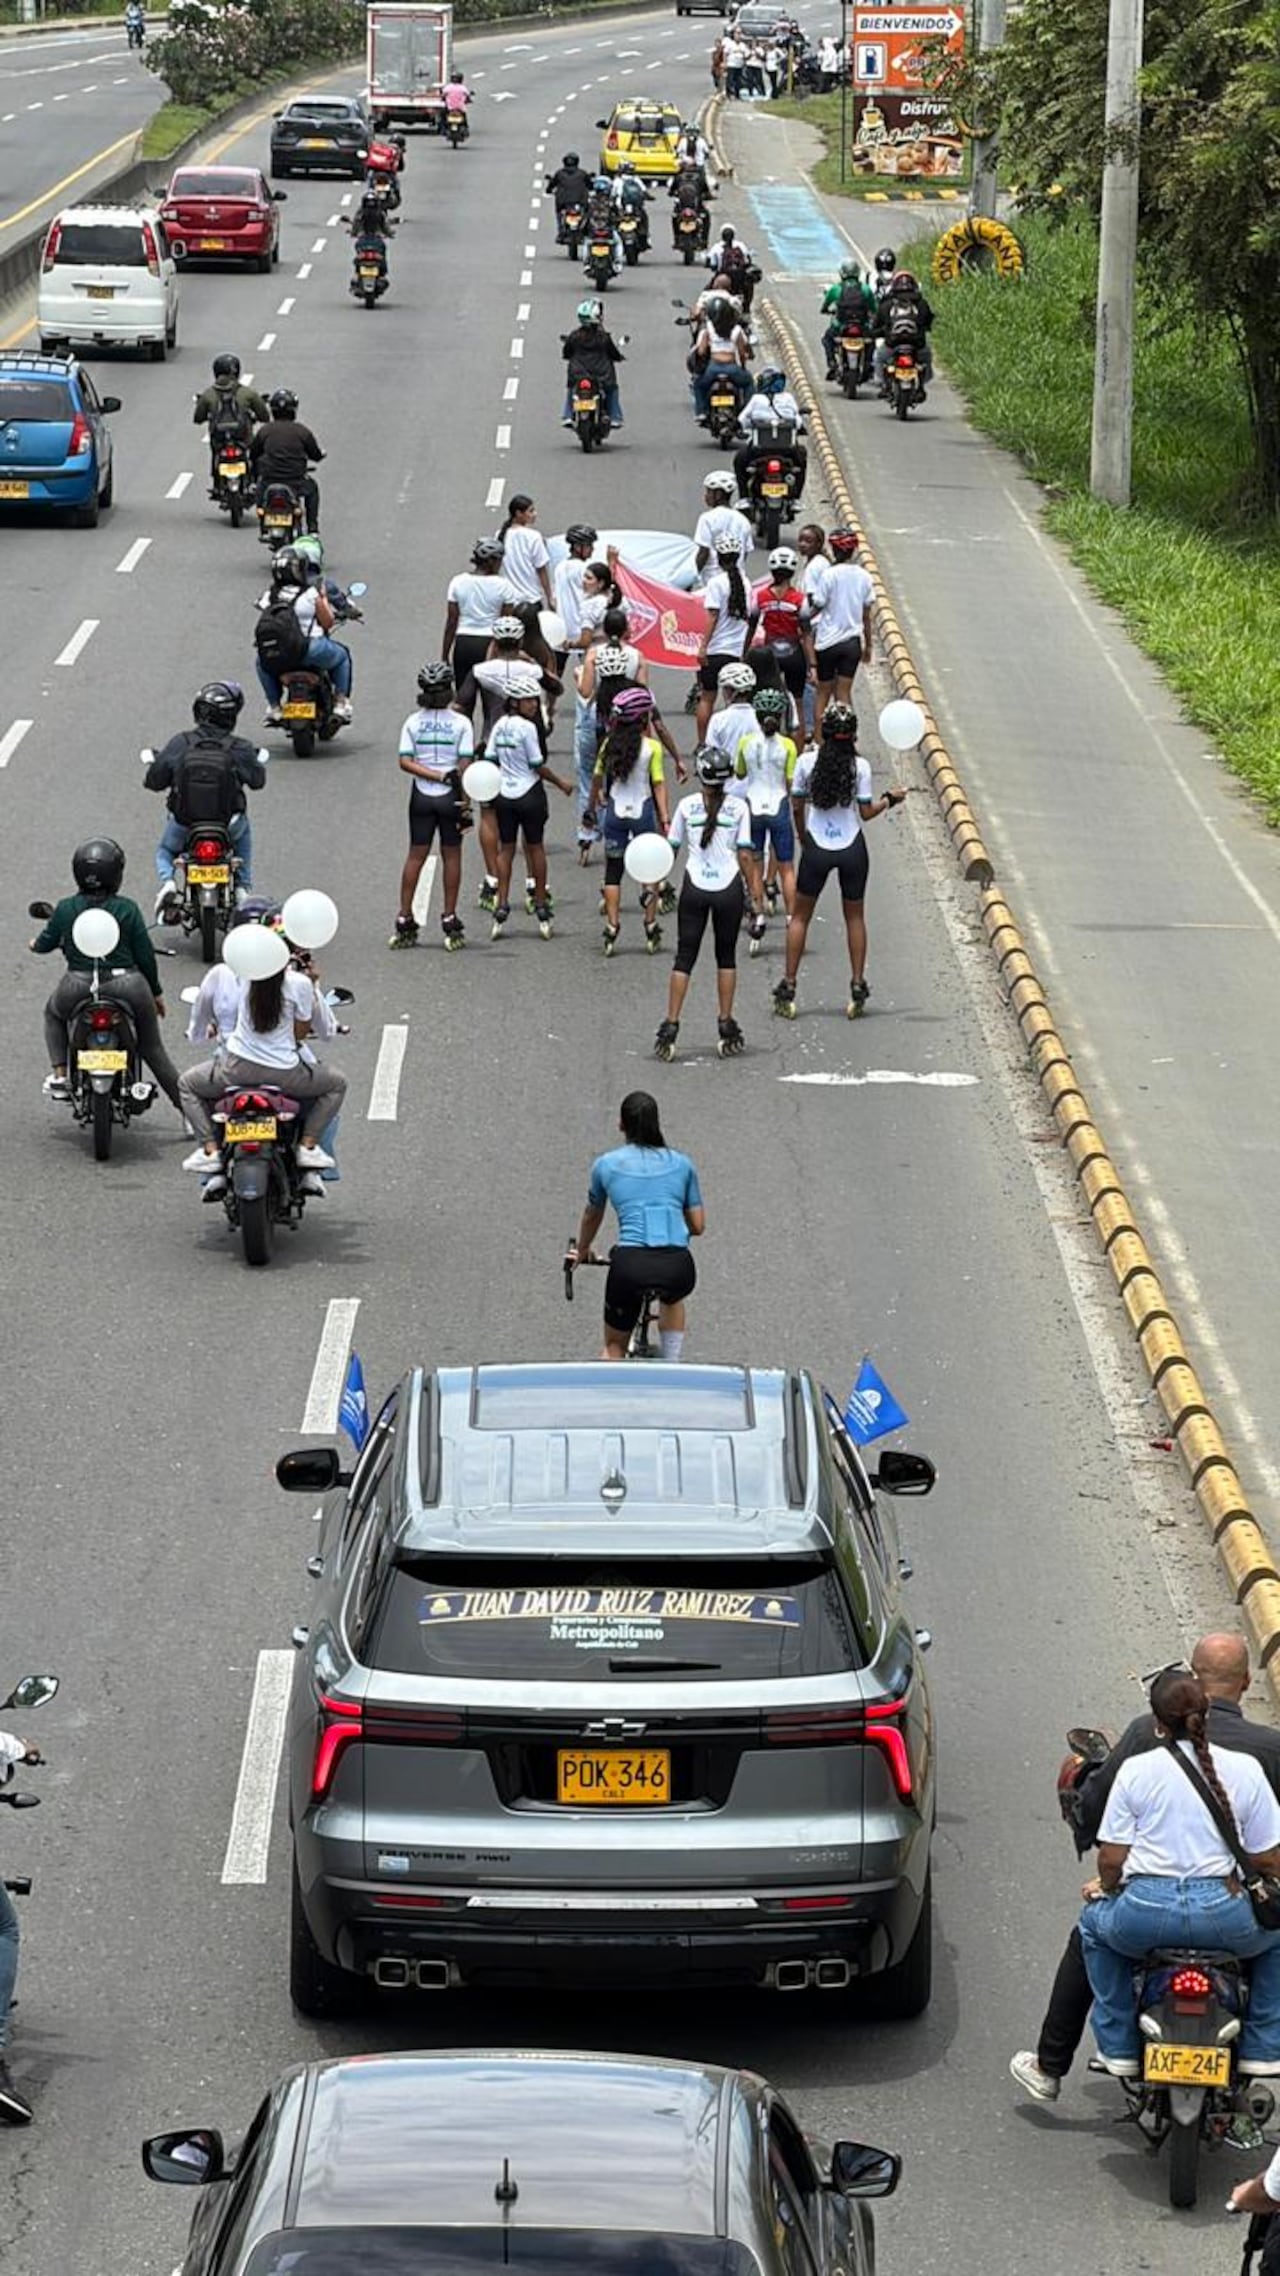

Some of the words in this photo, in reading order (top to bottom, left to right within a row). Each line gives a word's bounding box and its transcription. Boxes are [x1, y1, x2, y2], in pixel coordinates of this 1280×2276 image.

[860, 18, 955, 29] BIENVENIDOS
[458, 1591, 515, 1617] JUAN
[520, 1589, 591, 1615] DAVID
[596, 1589, 655, 1614] RUIZ
[660, 1591, 755, 1617] RAMIREZ
[550, 1624, 664, 1642] Metropolitano
